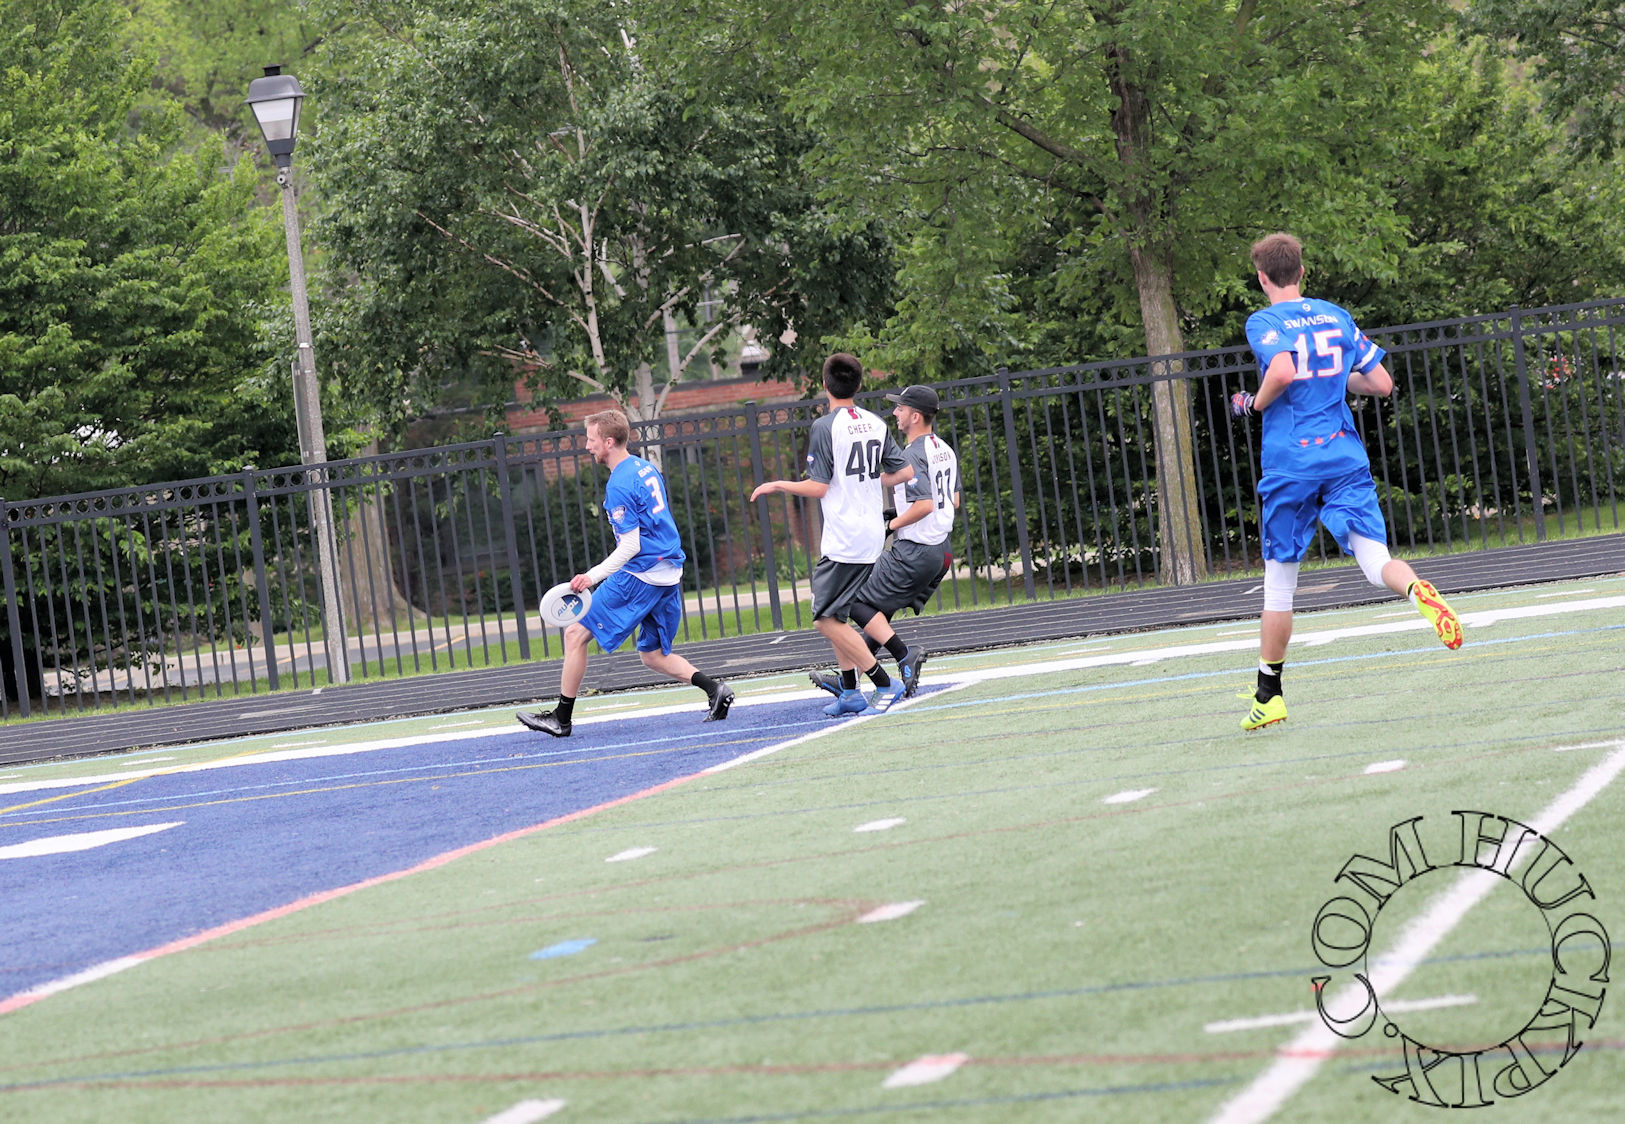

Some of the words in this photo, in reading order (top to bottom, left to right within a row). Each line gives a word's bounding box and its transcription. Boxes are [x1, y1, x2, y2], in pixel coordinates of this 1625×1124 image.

[1283, 314, 1339, 329] SWANSON
[1292, 328, 1343, 380] 15
[845, 439, 882, 482] 40
[644, 476, 665, 514] 3
